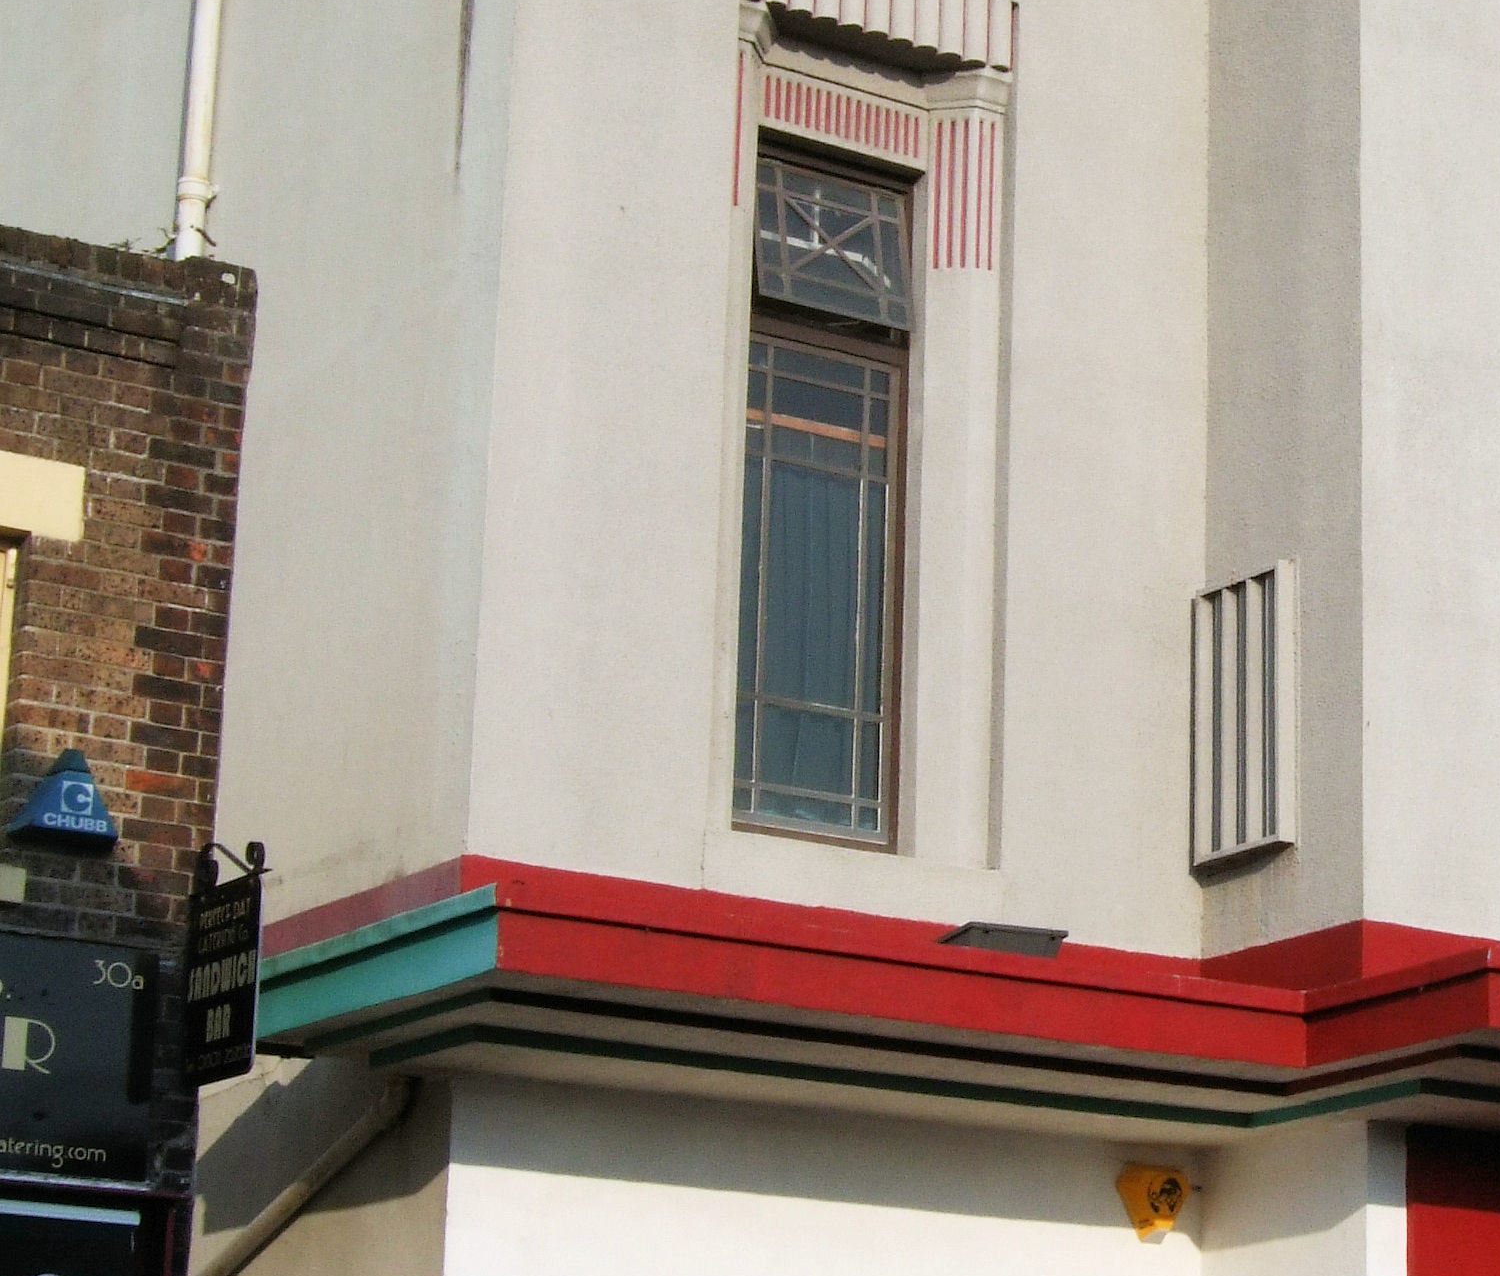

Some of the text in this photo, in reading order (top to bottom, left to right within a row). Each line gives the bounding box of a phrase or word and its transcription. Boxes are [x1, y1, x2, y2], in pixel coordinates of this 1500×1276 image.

[43, 811, 108, 833] CHUBB
[93, 959, 144, 990] 30a
[187, 949, 256, 1002] SANDWICH
[206, 1004, 231, 1042] BAR
